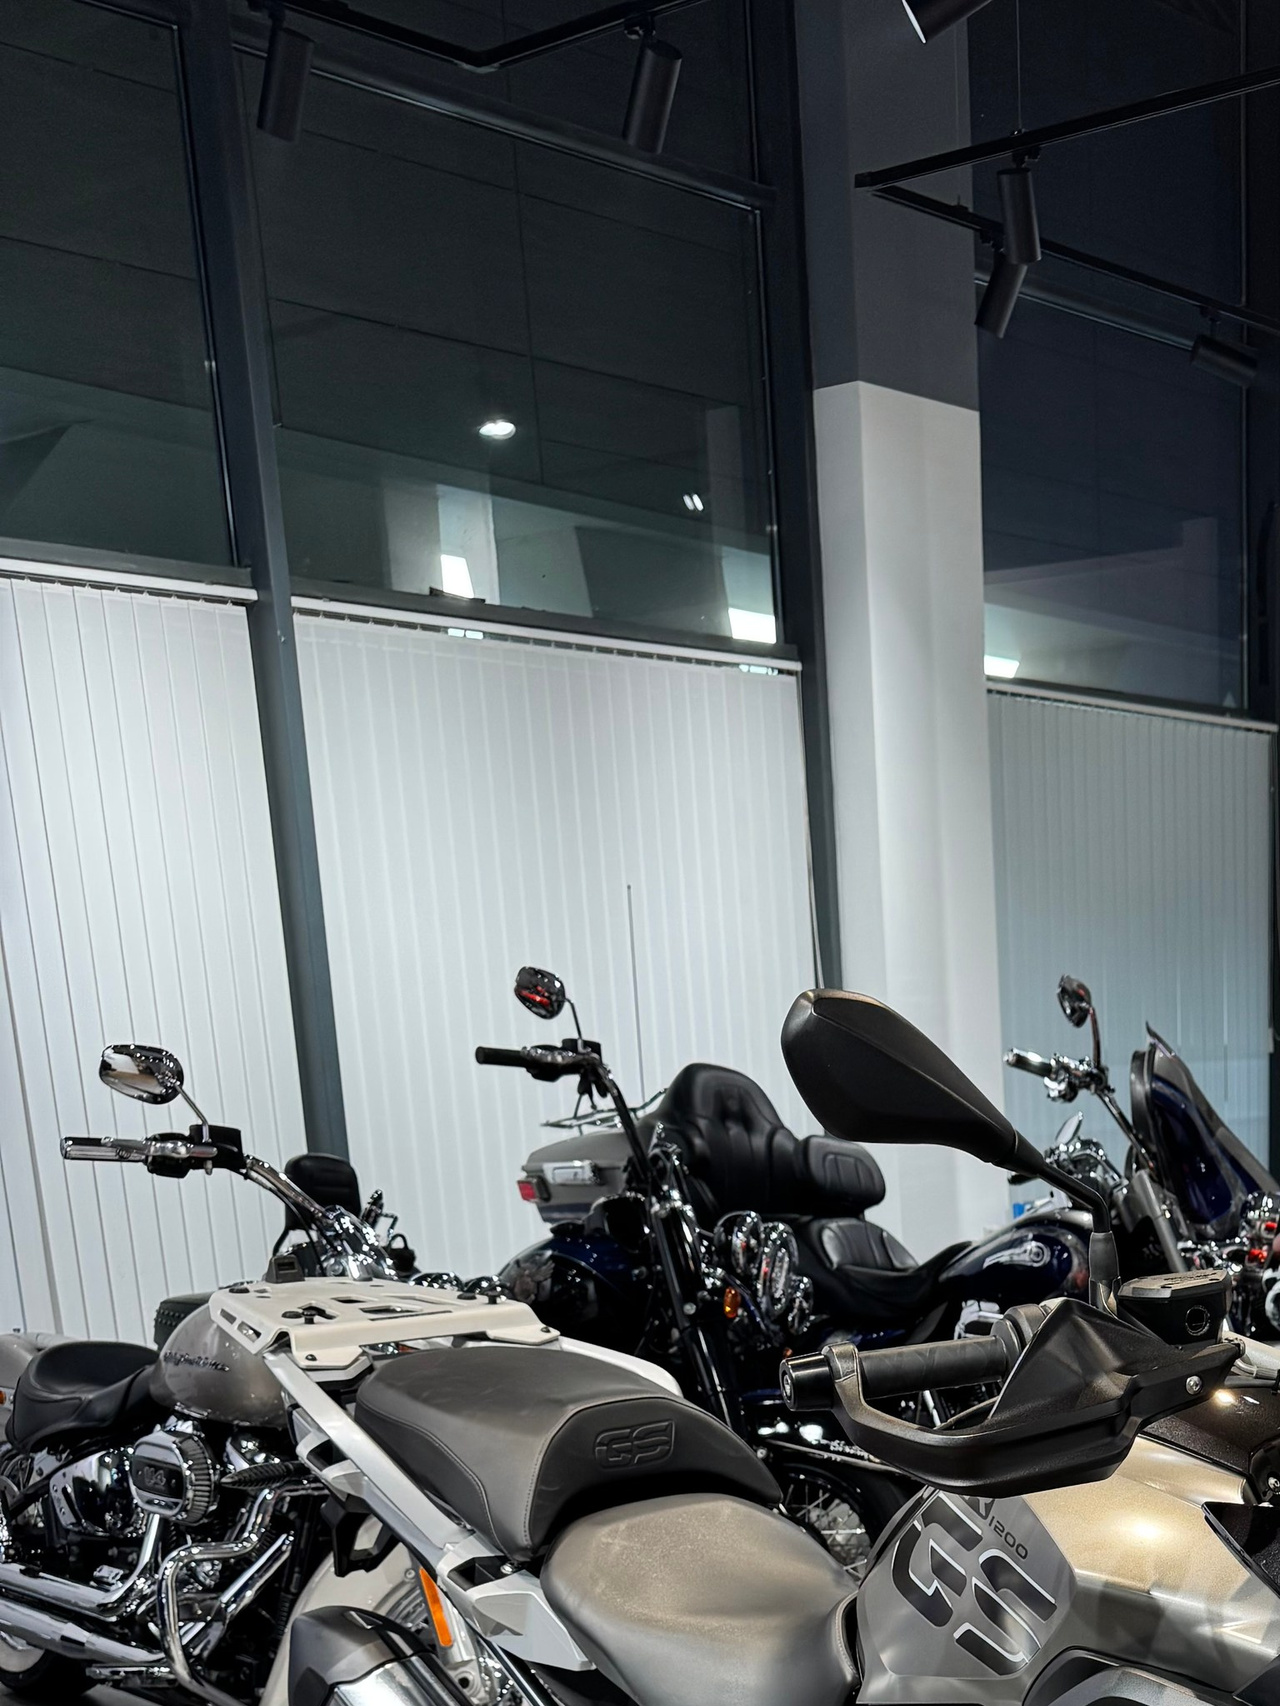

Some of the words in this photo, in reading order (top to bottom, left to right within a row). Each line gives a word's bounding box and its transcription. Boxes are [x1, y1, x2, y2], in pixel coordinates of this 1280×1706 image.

[593, 1419, 676, 1471] GS
[988, 1515, 1029, 1560] 1200
[891, 1492, 1058, 1676] GS
